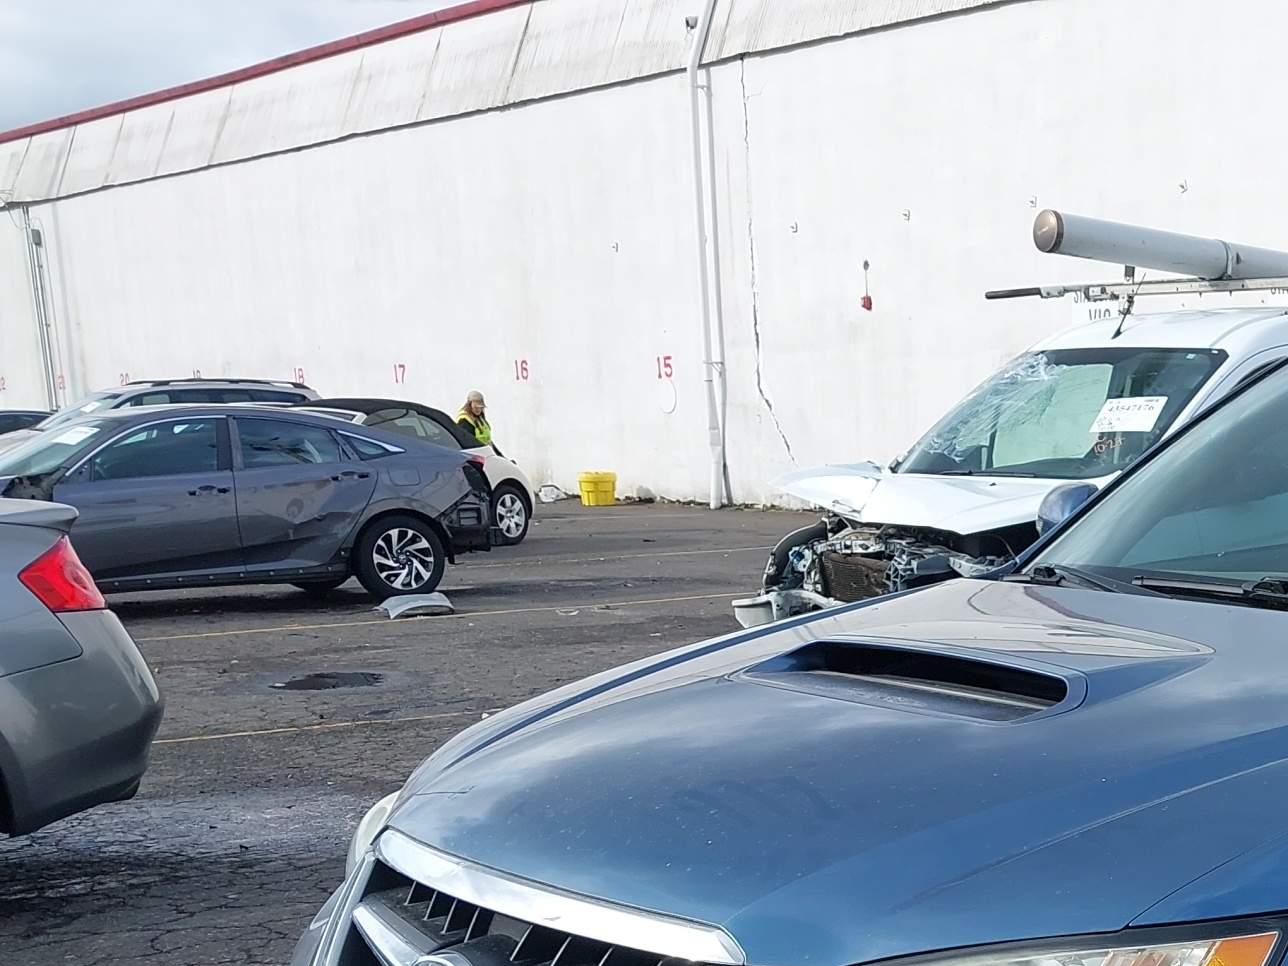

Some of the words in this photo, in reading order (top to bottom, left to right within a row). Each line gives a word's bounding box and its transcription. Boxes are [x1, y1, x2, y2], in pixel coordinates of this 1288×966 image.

[393, 364, 406, 383] 17
[514, 359, 528, 381] 16
[656, 356, 672, 379] 15
